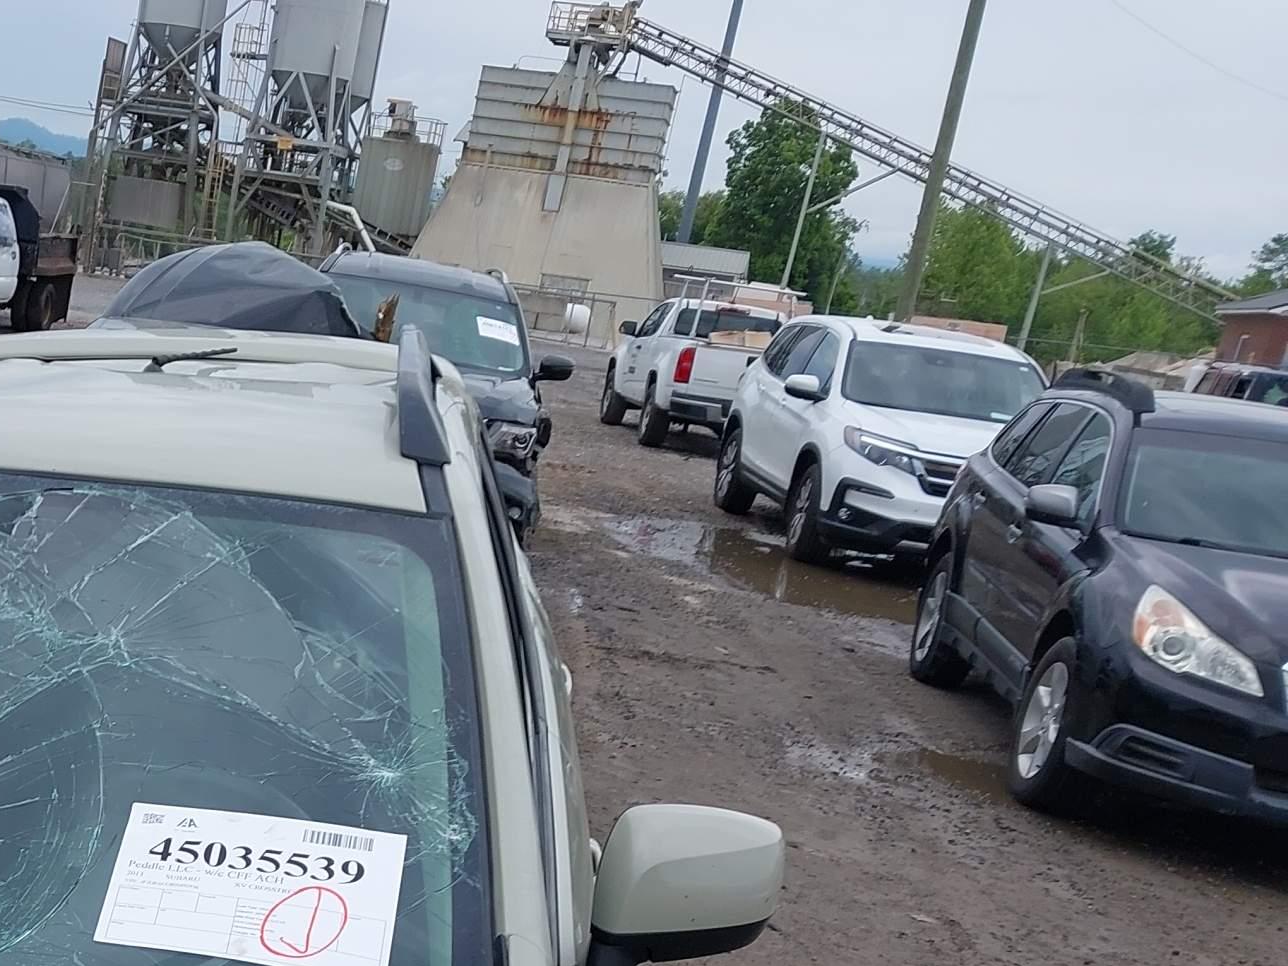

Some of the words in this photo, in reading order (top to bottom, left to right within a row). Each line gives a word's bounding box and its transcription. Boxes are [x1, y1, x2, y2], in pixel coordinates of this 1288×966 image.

[128, 859, 165, 872] Peddle
[168, 864, 194, 874] LLC
[255, 874, 285, 885] ACH
[149, 836, 365, 885] 45035539
